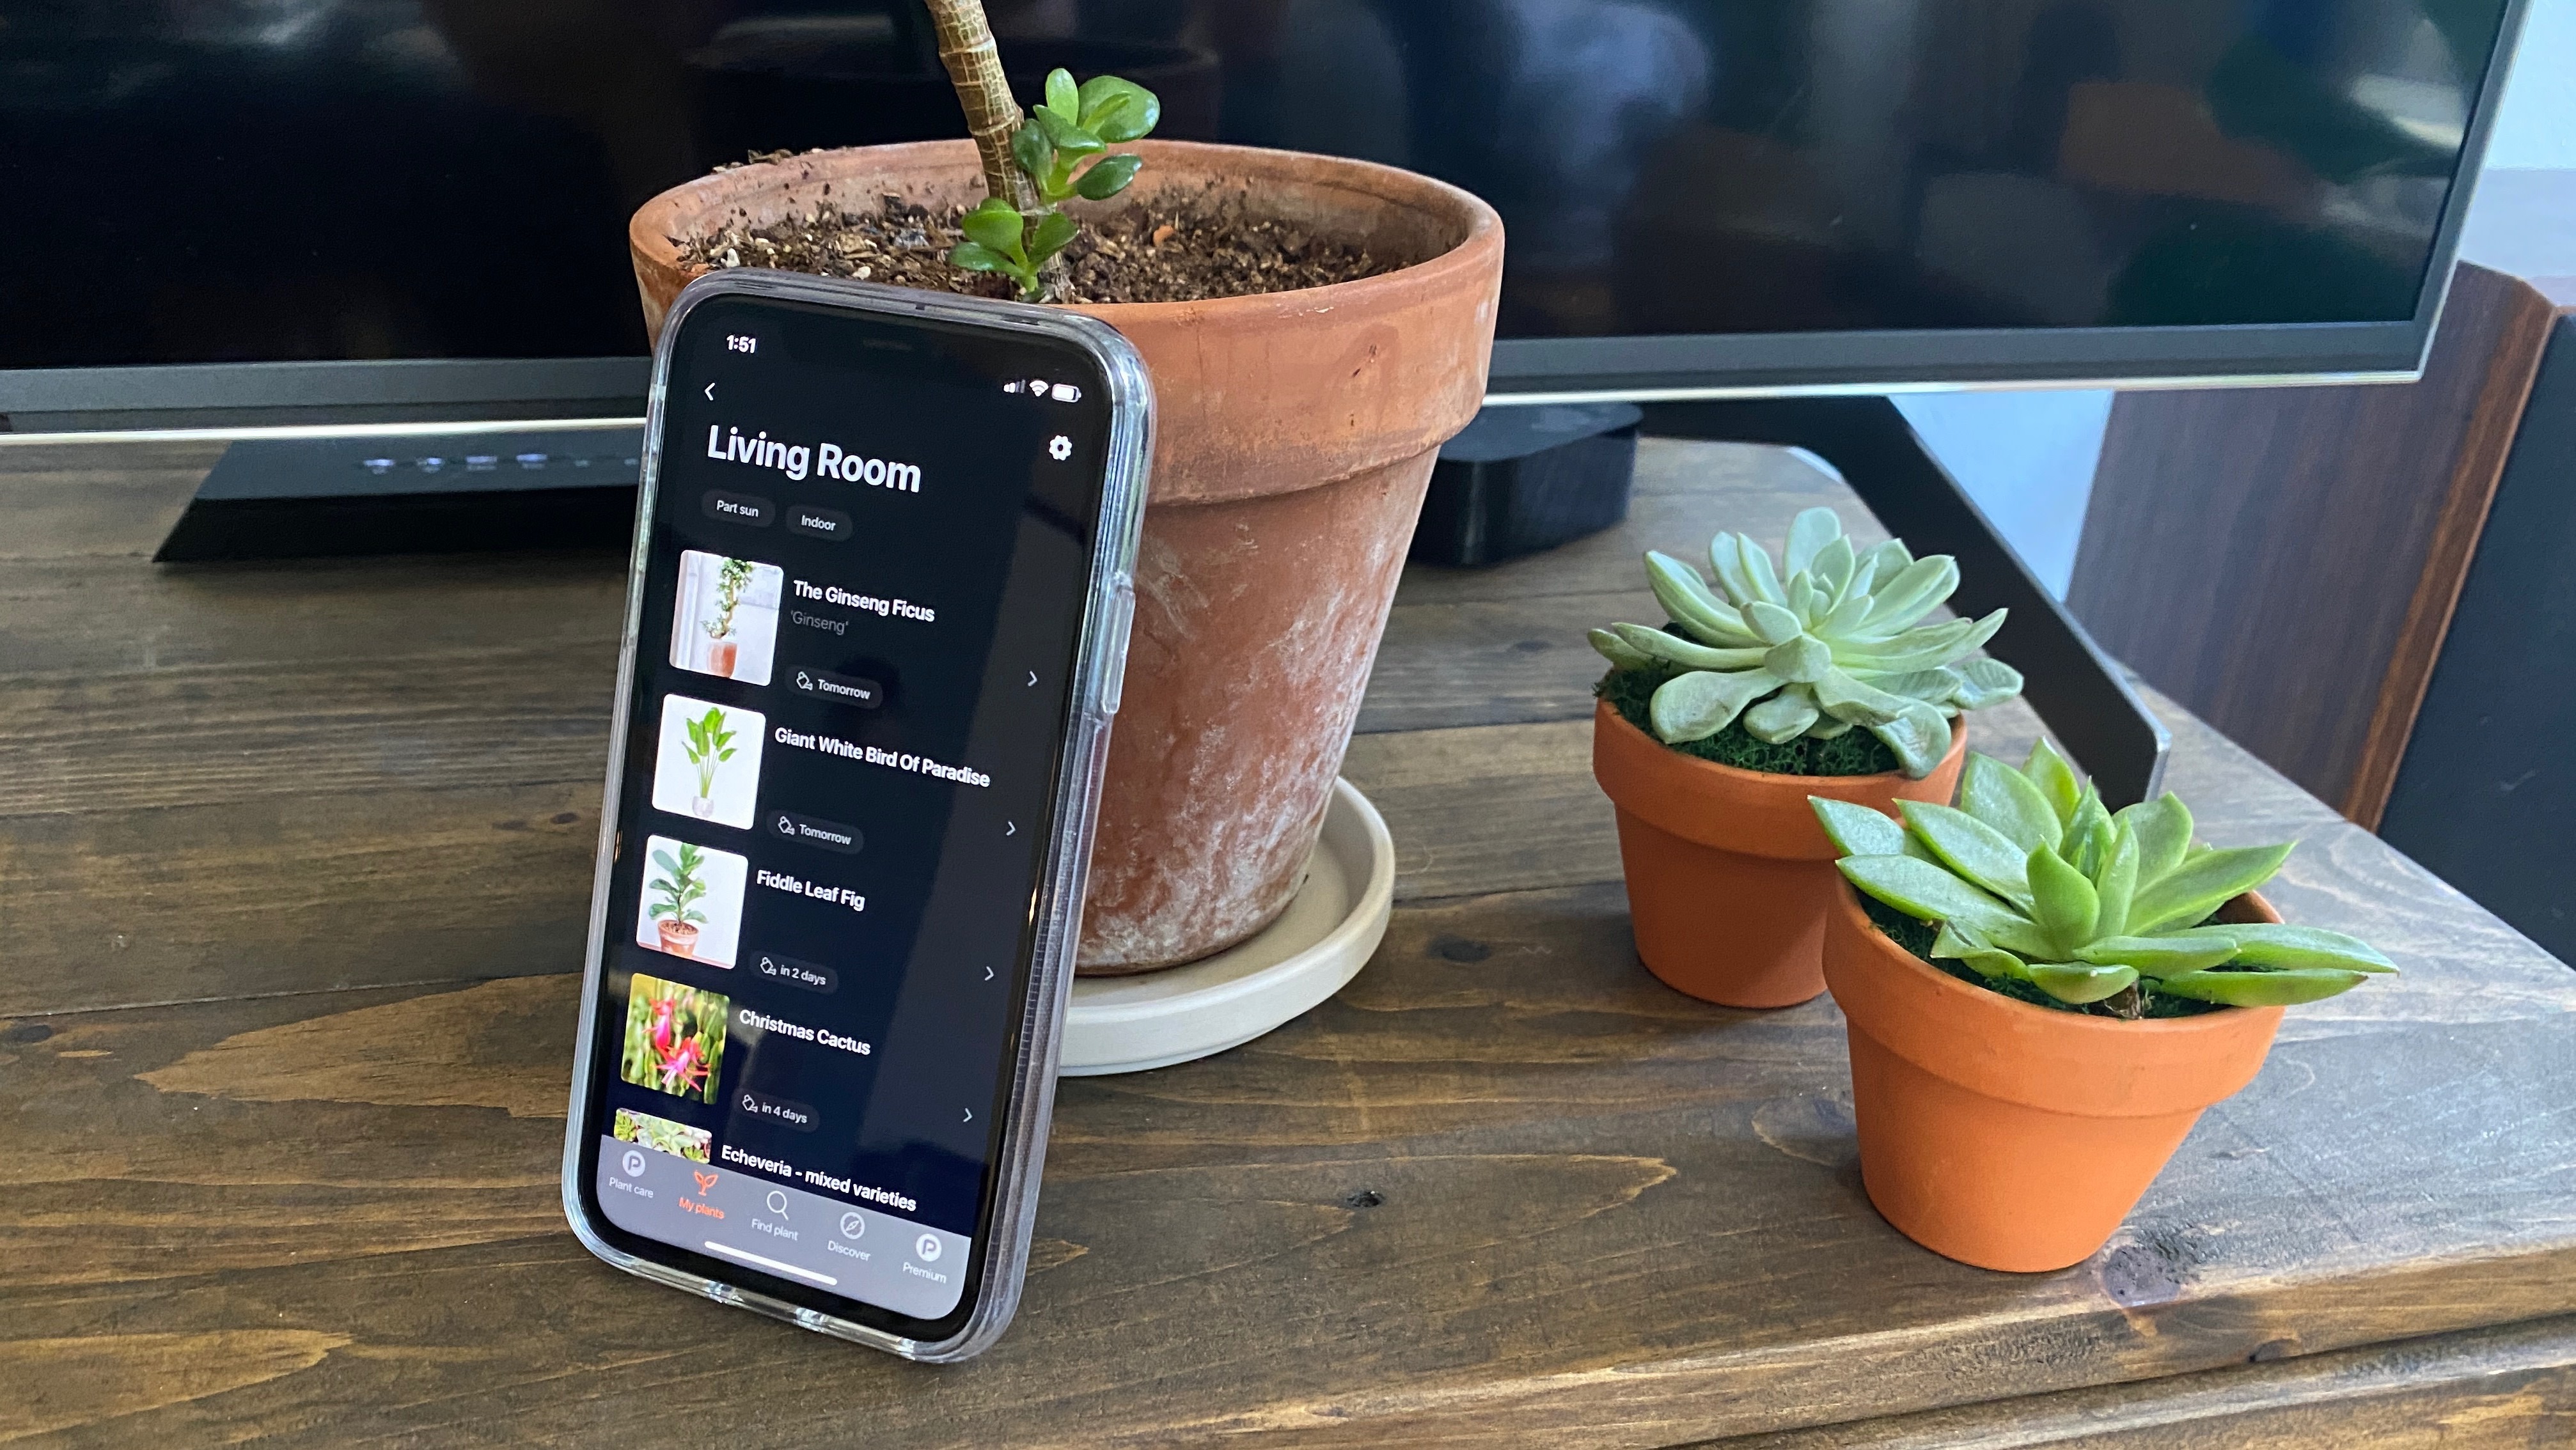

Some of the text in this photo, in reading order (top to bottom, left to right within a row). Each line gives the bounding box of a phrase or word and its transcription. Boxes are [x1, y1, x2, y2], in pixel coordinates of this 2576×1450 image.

[726, 334, 757, 354] 1:51
[708, 424, 922, 493] Living Room
[717, 500, 759, 517] Part sun
[801, 515, 836, 531] Indoor
[794, 580, 936, 623] The Ginseng Ficus
[790, 610, 849, 635] 'Ginseng'
[817, 678, 871, 701] Tomorrow
[774, 727, 991, 788] Giant White Bird Of Paradise
[799, 823, 852, 845] Tomorrow
[757, 869, 866, 912] Fiddle Leaf Fig
[780, 964, 827, 986] in 2 days
[739, 1009, 871, 1056] Christmas Cactus
[762, 1102, 808, 1125] in 4 days
[609, 1177, 654, 1198] Plant care
[721, 1144, 792, 1177] Echeveria
[805, 1169, 849, 1194] mixed
[853, 1182, 917, 1212] varieties
[679, 1197, 725, 1220] My plants
[751, 1219, 798, 1242] Find plant
[828, 1240, 870, 1262] Discover
[902, 1262, 947, 1284] Premium
